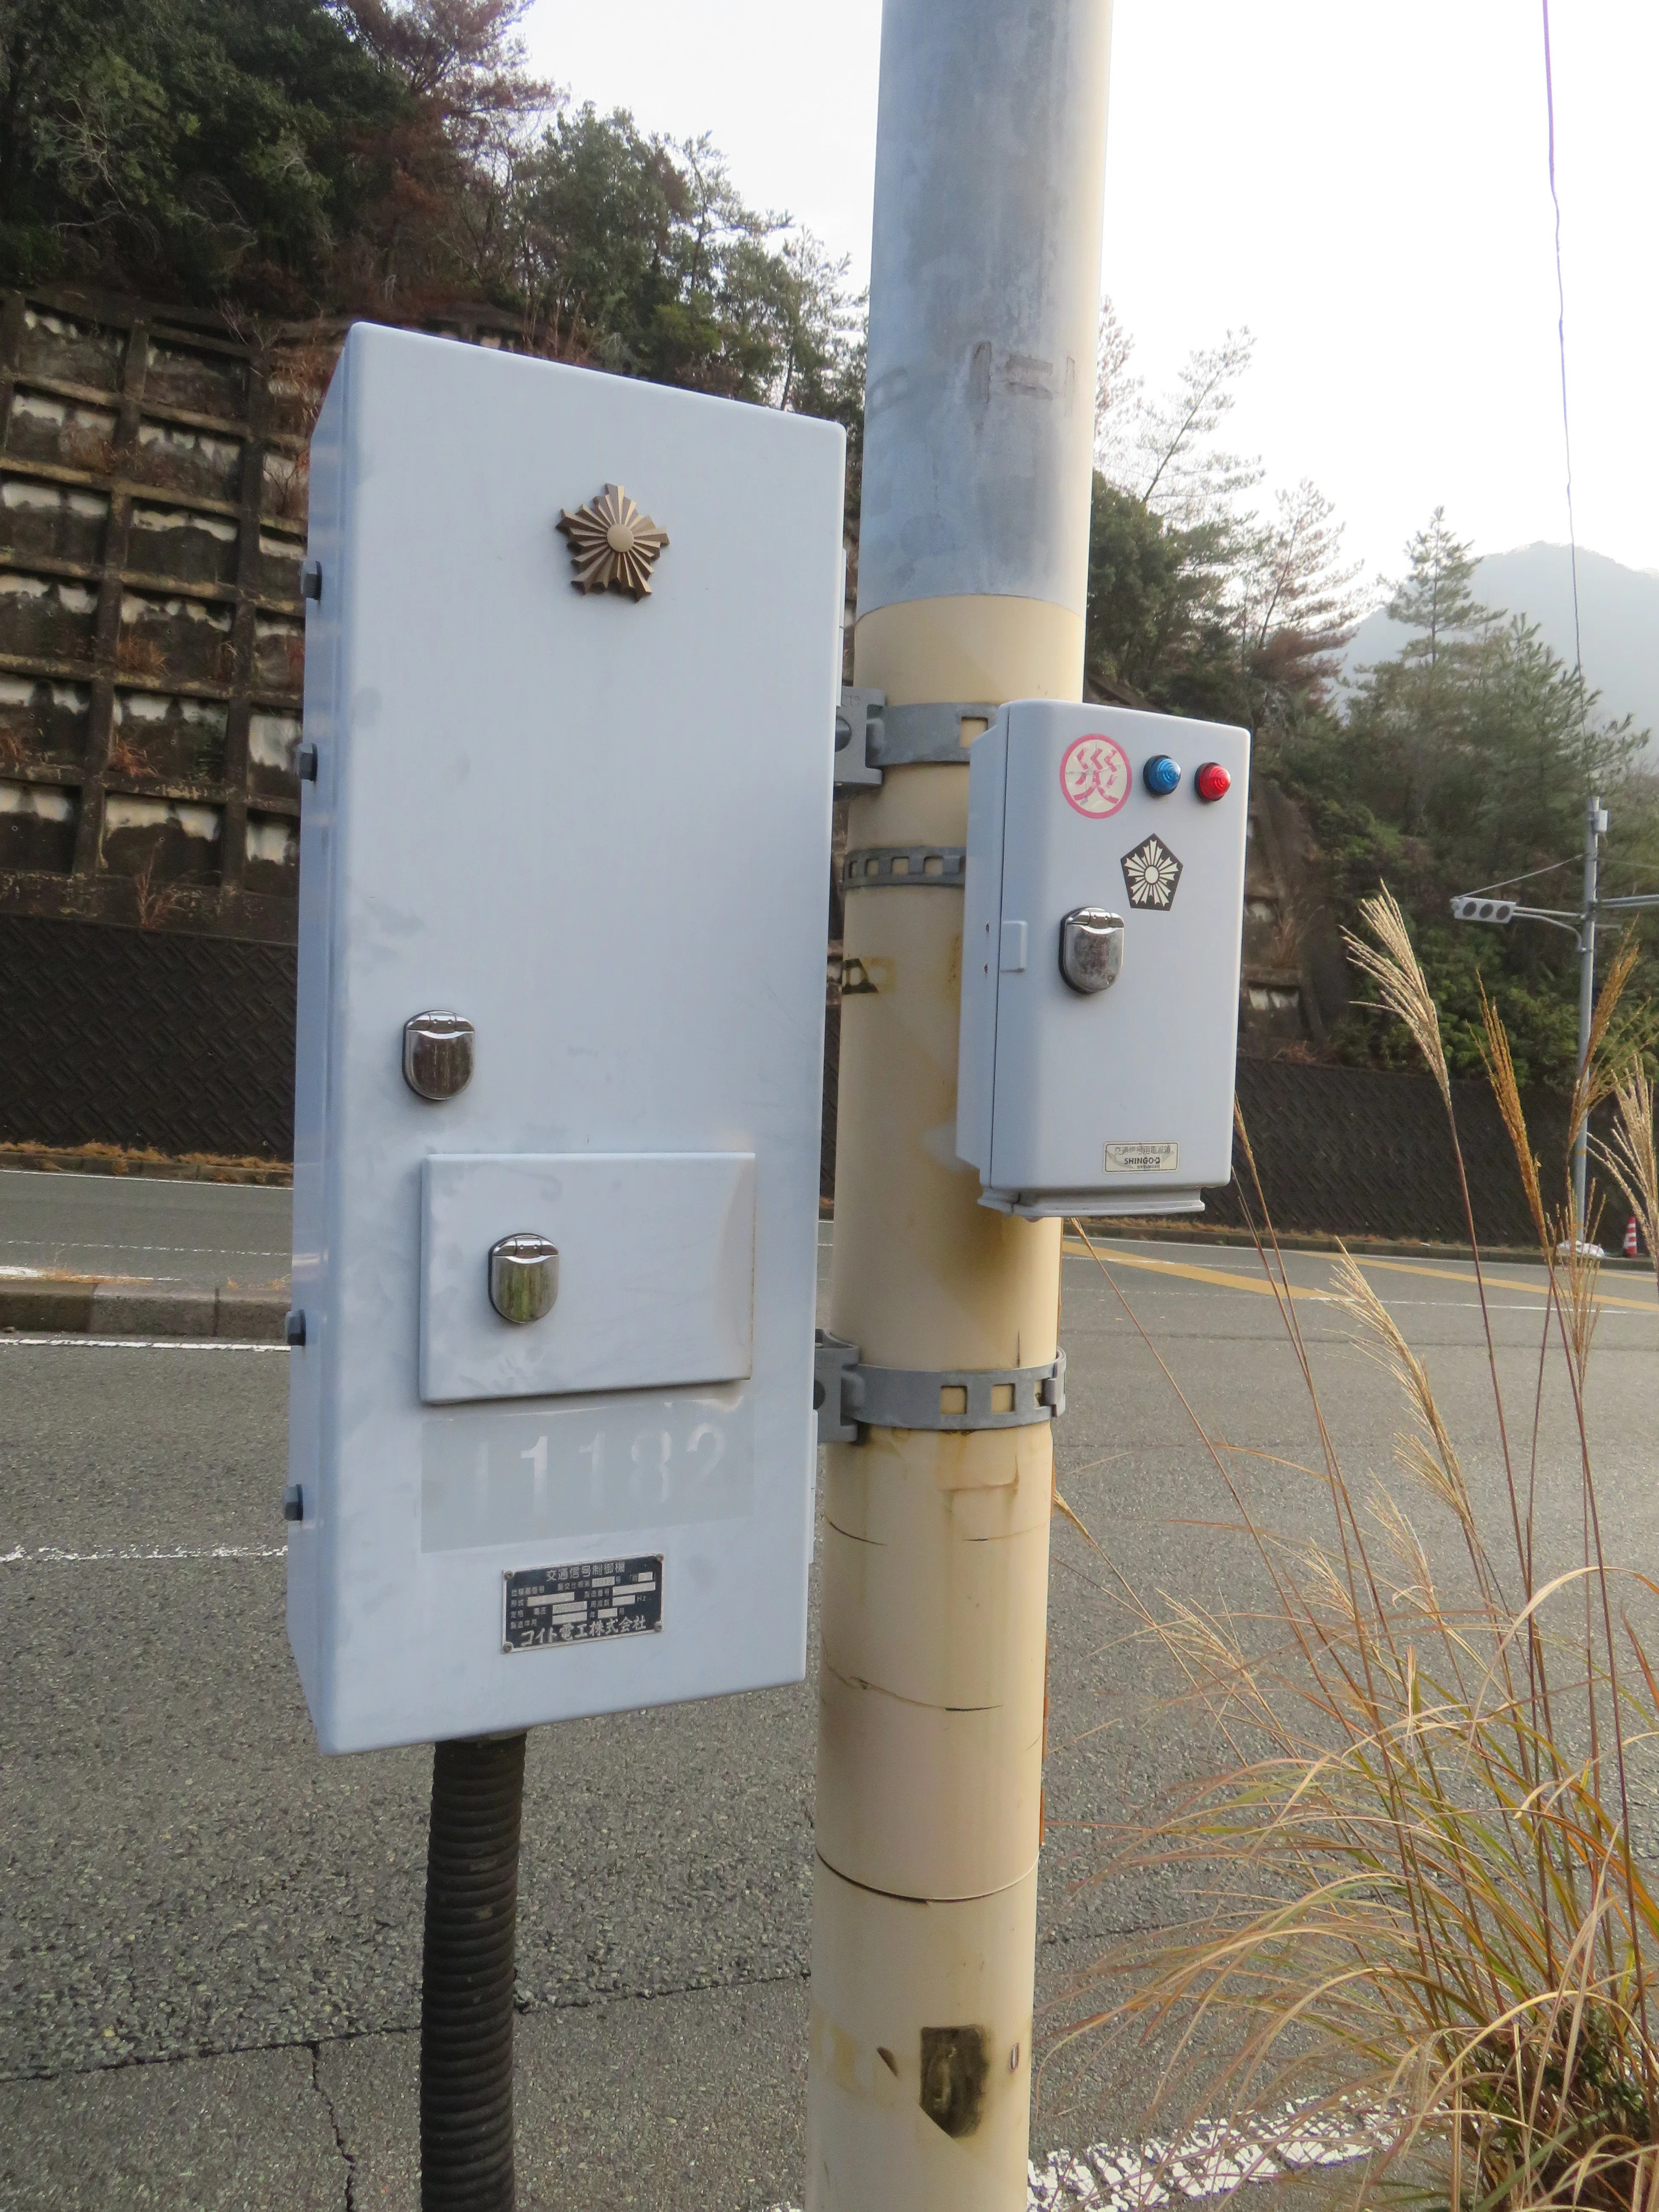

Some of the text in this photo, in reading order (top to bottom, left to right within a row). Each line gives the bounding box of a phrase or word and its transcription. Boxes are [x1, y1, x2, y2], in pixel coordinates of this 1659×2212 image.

[1074, 748, 1120, 804] 災
[546, 1560, 626, 1581] 交通信号制御機
[521, 1615, 646, 1647] コイト電工株式会社
